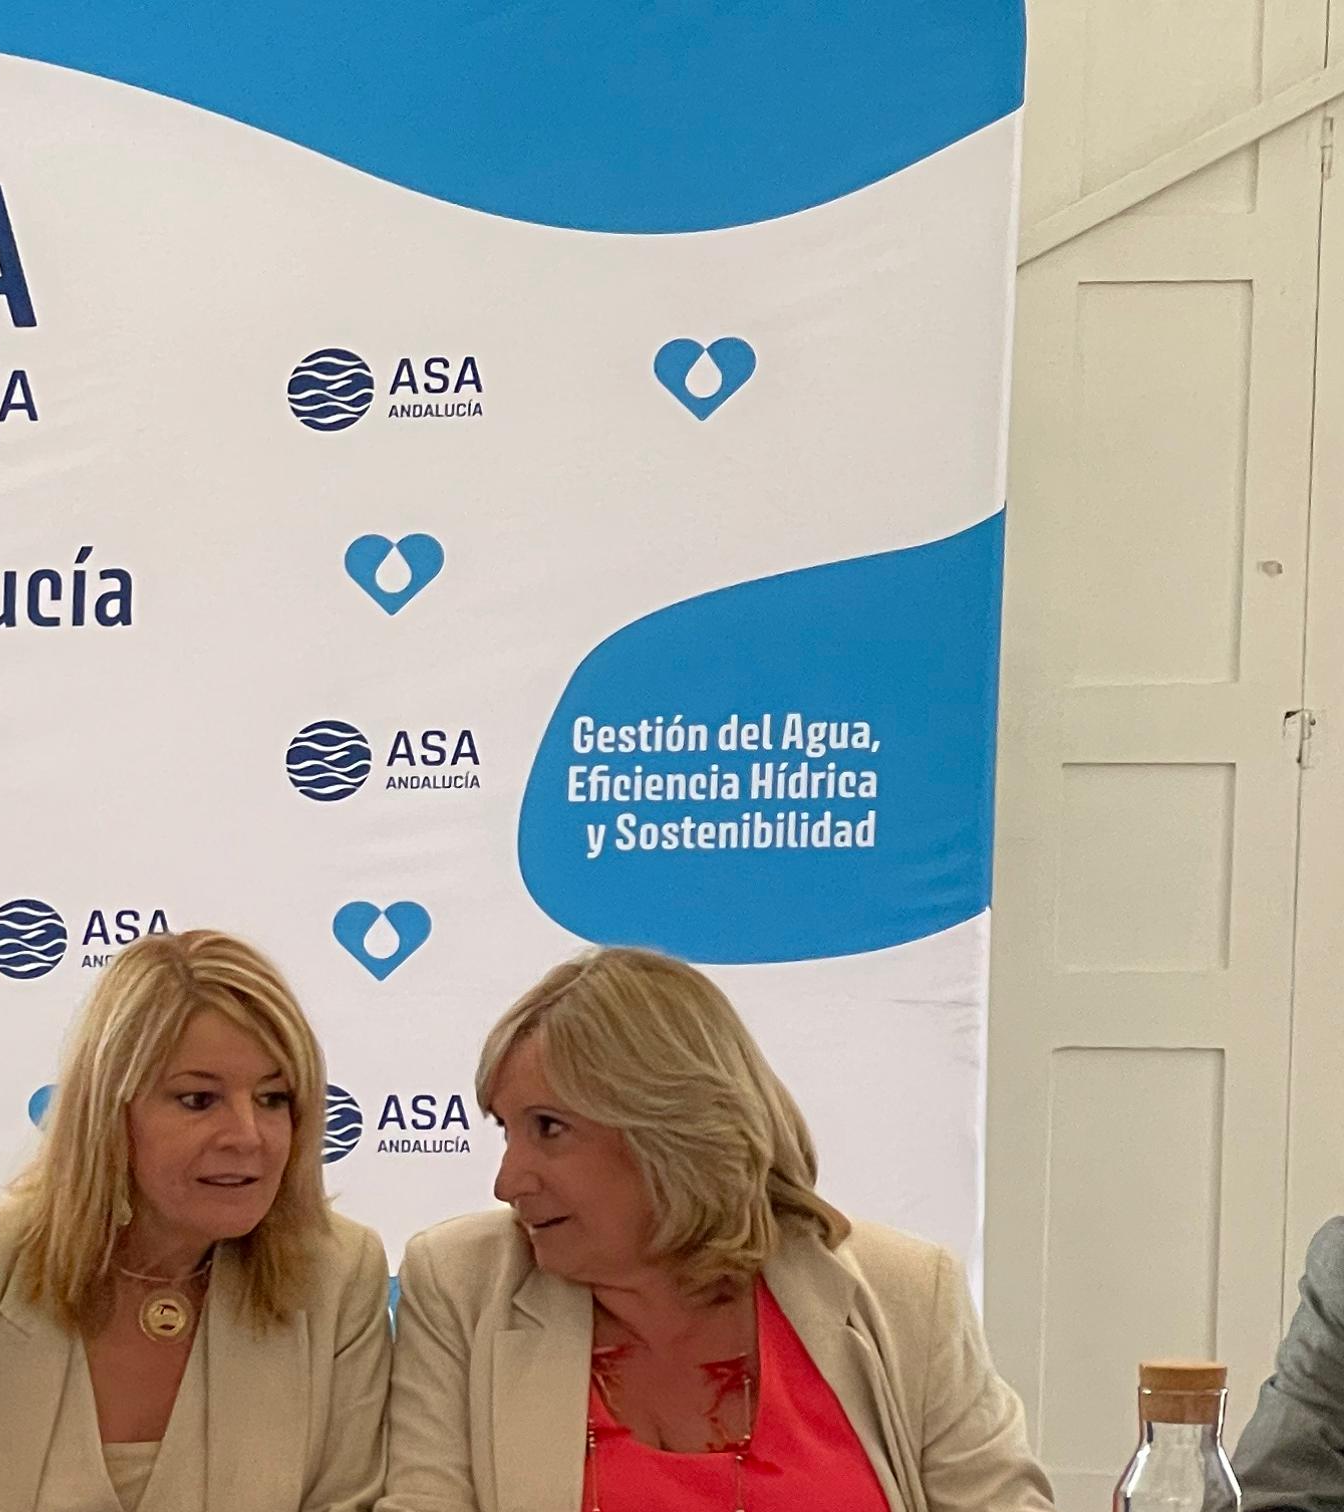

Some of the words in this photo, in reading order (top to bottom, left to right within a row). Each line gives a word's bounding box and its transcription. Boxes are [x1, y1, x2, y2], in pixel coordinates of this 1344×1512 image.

[390, 357, 483, 394] ASA
[388, 400, 483, 418] ANDALUCÍA
[388, 730, 480, 767] ASA
[573, 715, 706, 754] Gestión
[718, 712, 772, 750] del
[781, 713, 881, 756] Agua,
[386, 772, 480, 790] ANDALUCÍA
[568, 764, 739, 802] Eficiencia
[751, 761, 877, 799] Hídrica
[586, 824, 604, 859] y
[615, 811, 875, 851] Sostenibilidad
[81, 908, 172, 946] ASA
[377, 1094, 470, 1131] ASA
[377, 1134, 471, 1154] ANDALUCÍA
